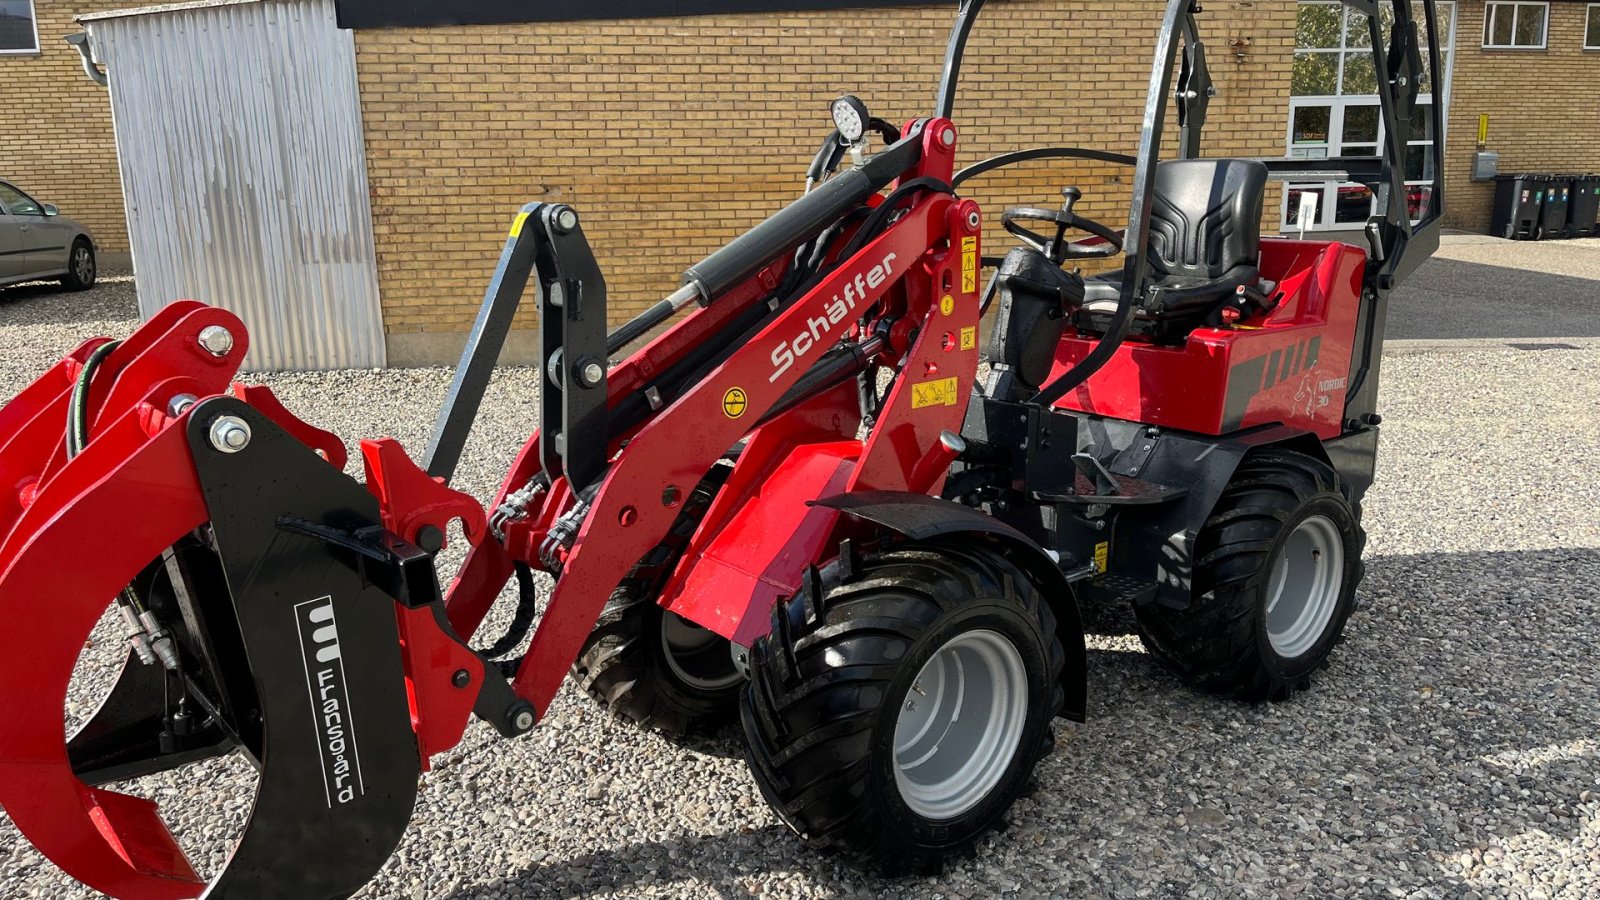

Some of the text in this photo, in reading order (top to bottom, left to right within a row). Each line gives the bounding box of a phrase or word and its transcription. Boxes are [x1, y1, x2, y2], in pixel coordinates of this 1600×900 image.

[769, 252, 896, 383] Schäffer
[1319, 377, 1345, 392] NORDIC
[317, 668, 354, 804] Fransgård
